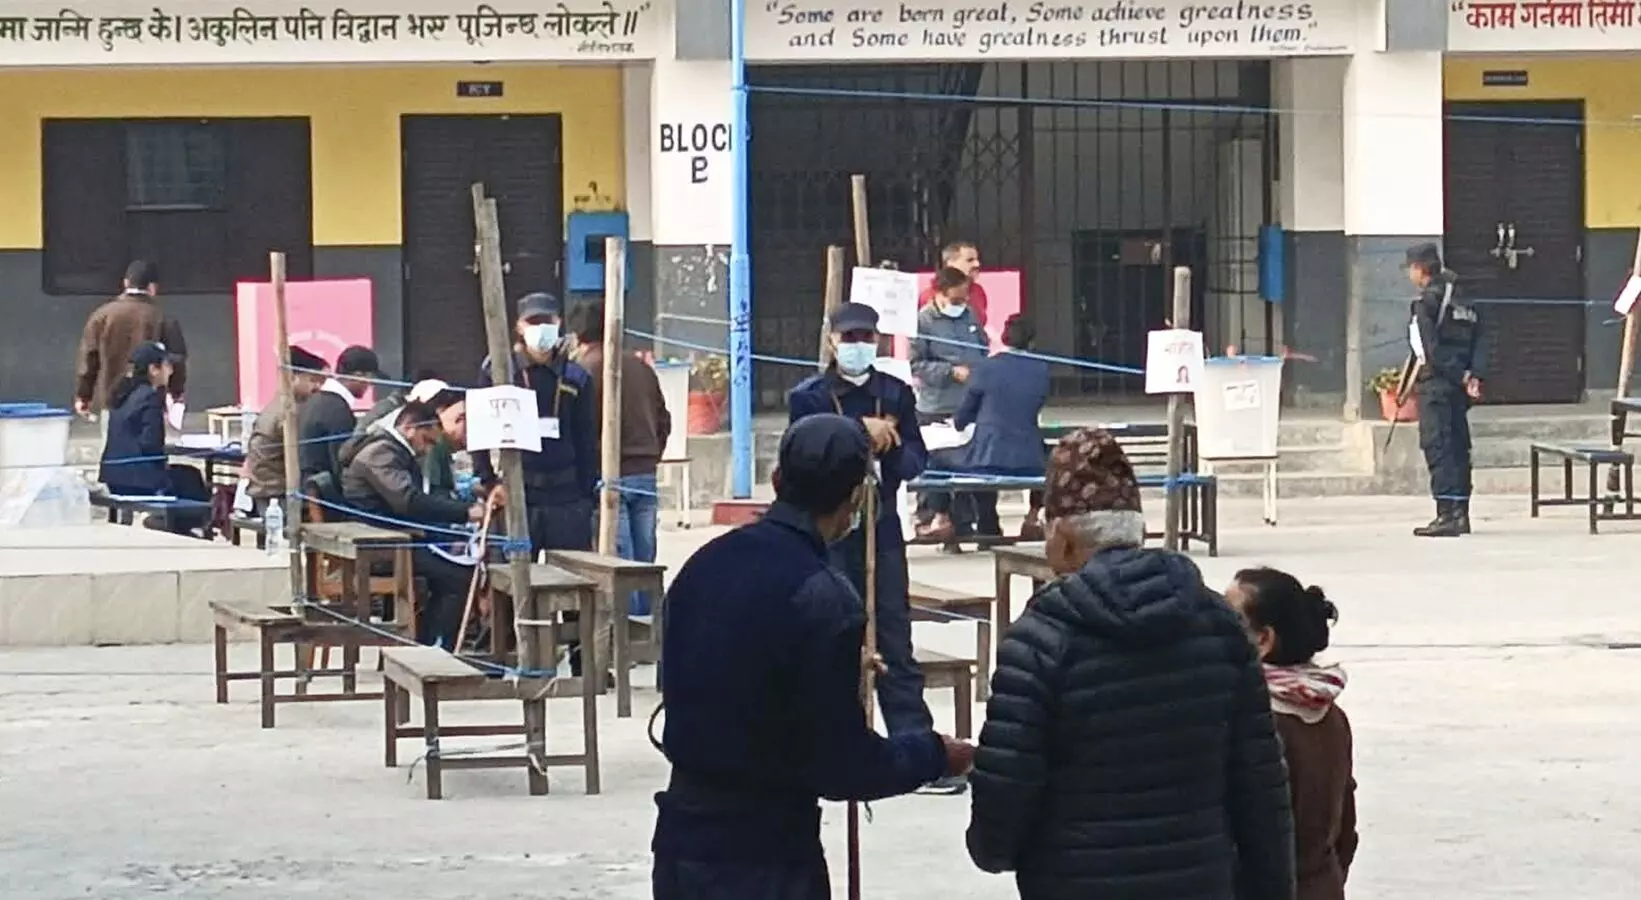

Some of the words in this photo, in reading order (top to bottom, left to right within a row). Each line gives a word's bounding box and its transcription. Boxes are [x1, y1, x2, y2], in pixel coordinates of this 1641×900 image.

[281, 7, 325, 41] पनि
[765, 1, 835, 25] "Some
[847, 8, 883, 24] are
[899, 2, 944, 24] born
[1025, 1, 1083, 23] Some
[1090, 0, 1166, 22] achieve
[1178, 0, 1314, 29] greatness
[788, 27, 835, 47] and
[852, 27, 909, 48] Some
[922, 29, 967, 47] have
[977, 30, 1087, 54] greatness
[1099, 27, 1168, 46] thrust
[1187, 28, 1239, 47] upon
[660, 123, 732, 152] BLOC
